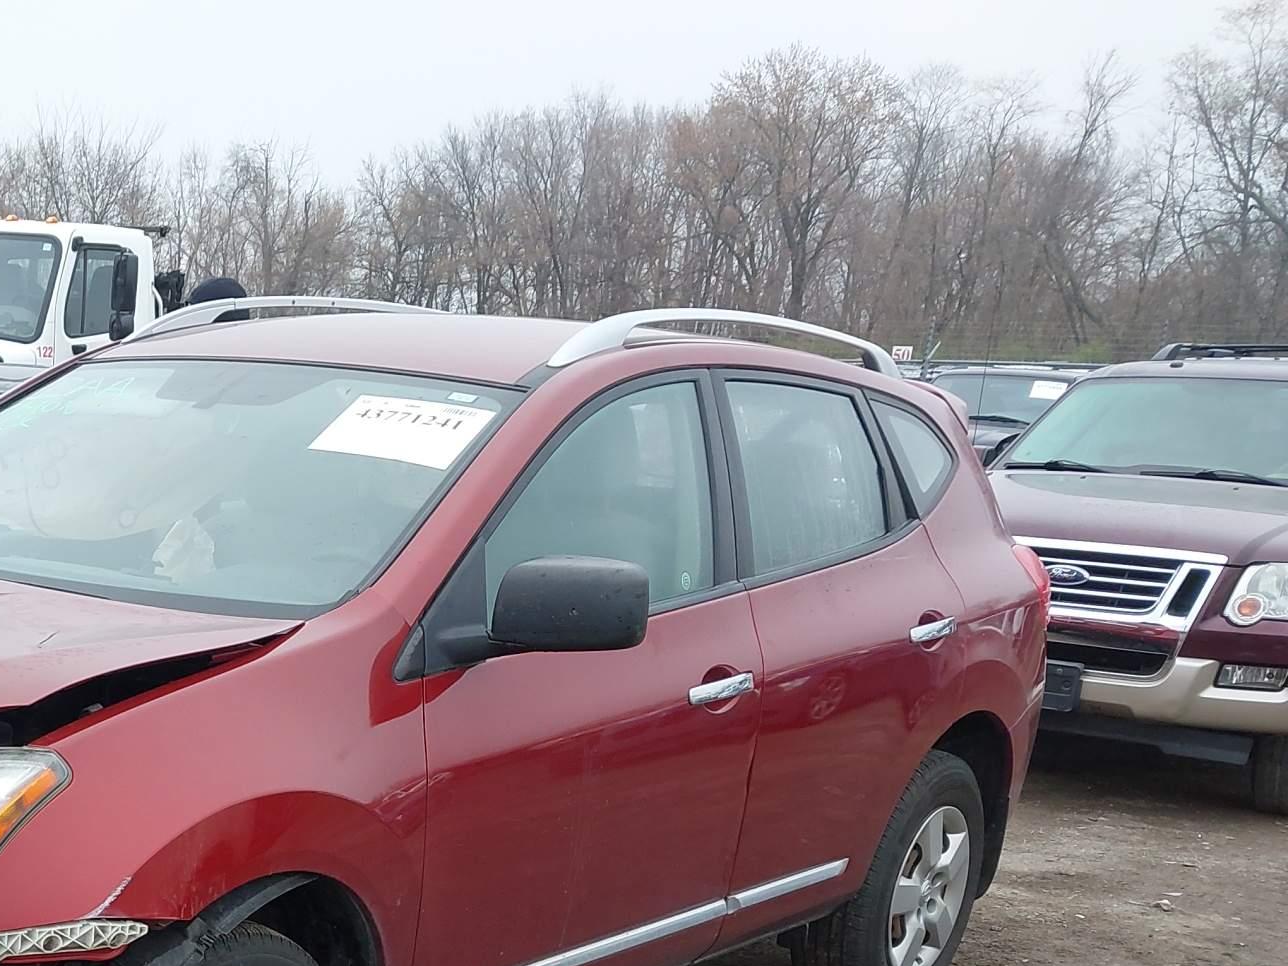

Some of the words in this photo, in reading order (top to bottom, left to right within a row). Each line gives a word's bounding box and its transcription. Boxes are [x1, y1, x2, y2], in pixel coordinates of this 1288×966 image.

[35, 345, 53, 358] 122
[893, 348, 910, 360] 50
[355, 407, 465, 430] 43771241
